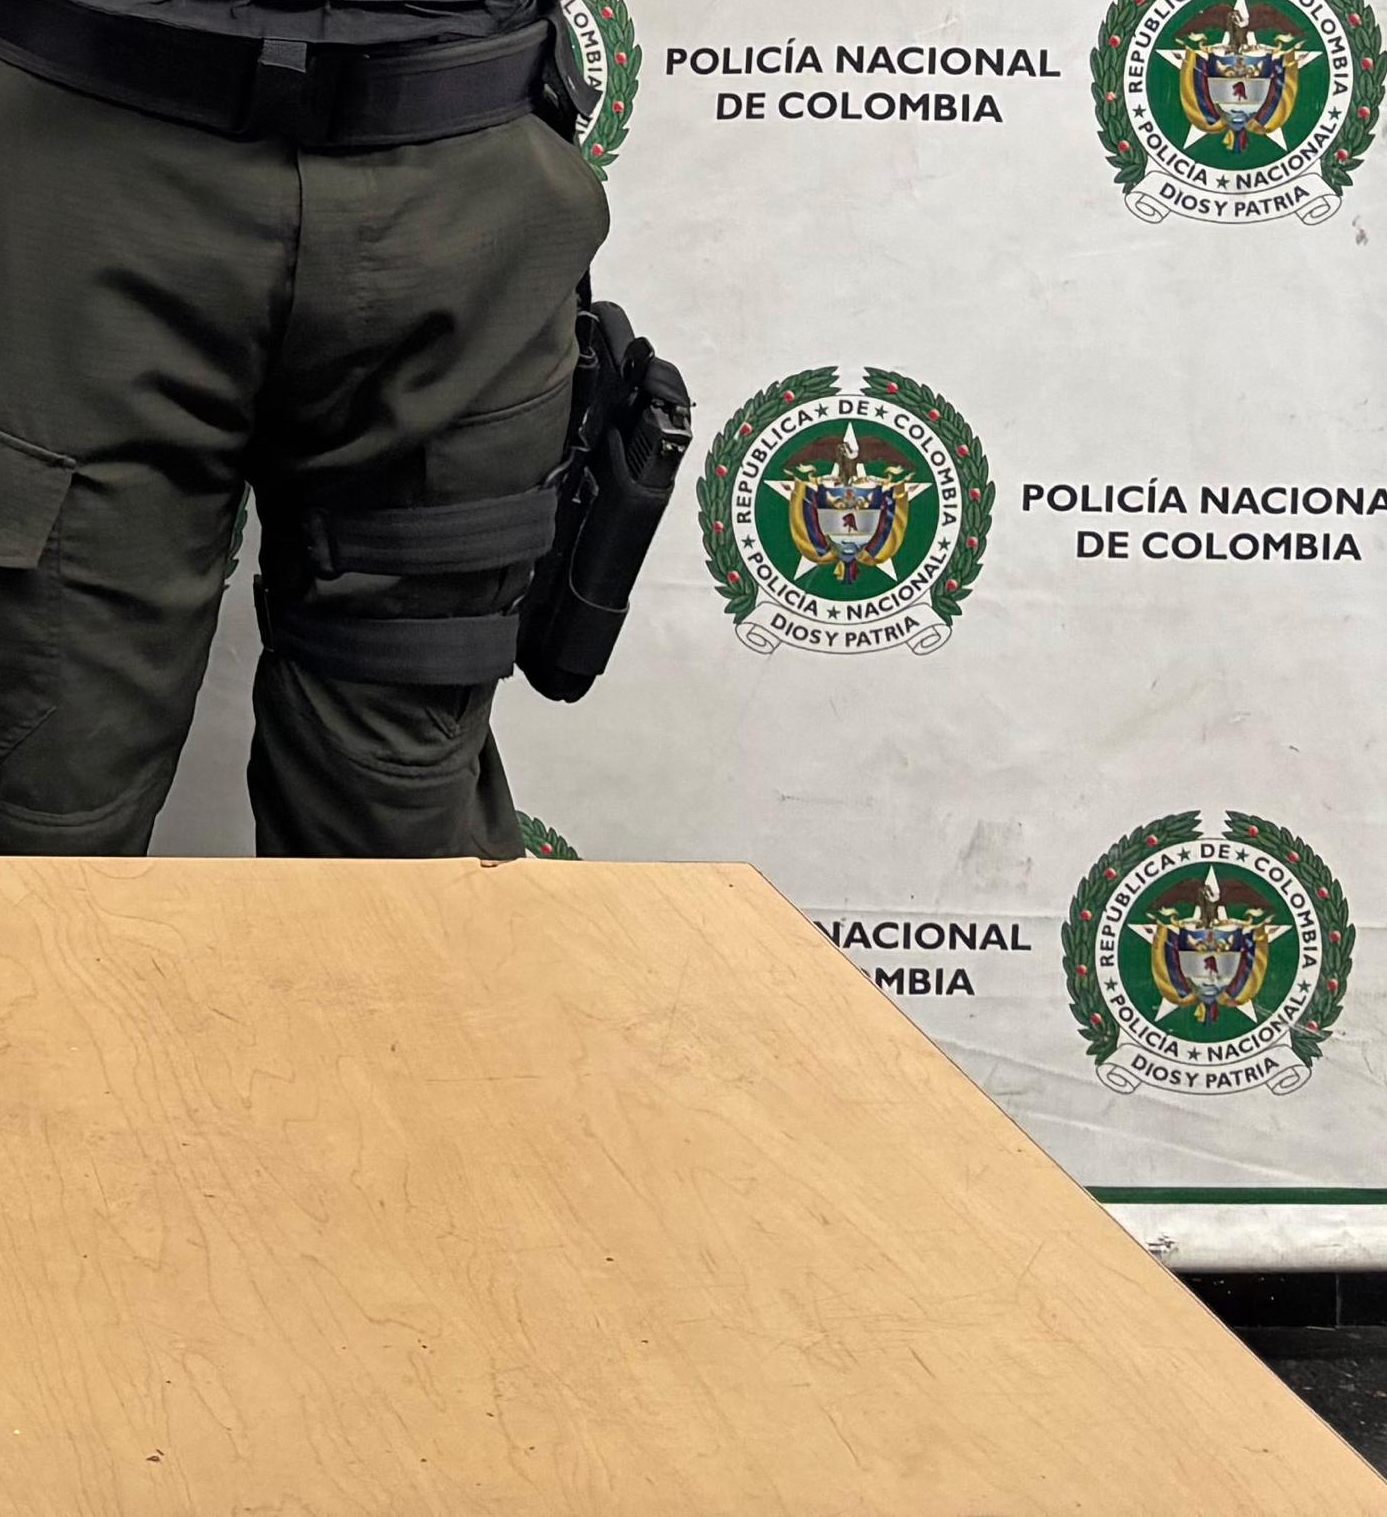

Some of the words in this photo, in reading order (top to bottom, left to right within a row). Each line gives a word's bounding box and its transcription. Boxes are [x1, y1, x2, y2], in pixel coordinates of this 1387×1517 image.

[667, 38, 822, 75] POLICÍA
[837, 46, 1060, 77] NACIONAL
[717, 93, 765, 119] DE
[779, 92, 1002, 122] COLOMBIA
[1023, 478, 1187, 513] POLICÍA
[1077, 531, 1128, 558] DE
[1143, 532, 1361, 560] COLOMBIA
[1201, 844, 1230, 859] DE
[1255, 857, 1317, 969] COLOMBIA
[1208, 996, 1306, 1062] NACIONAL
[1131, 1054, 1181, 1084] DIOS
[1206, 1058, 1279, 1088] PATRIA
